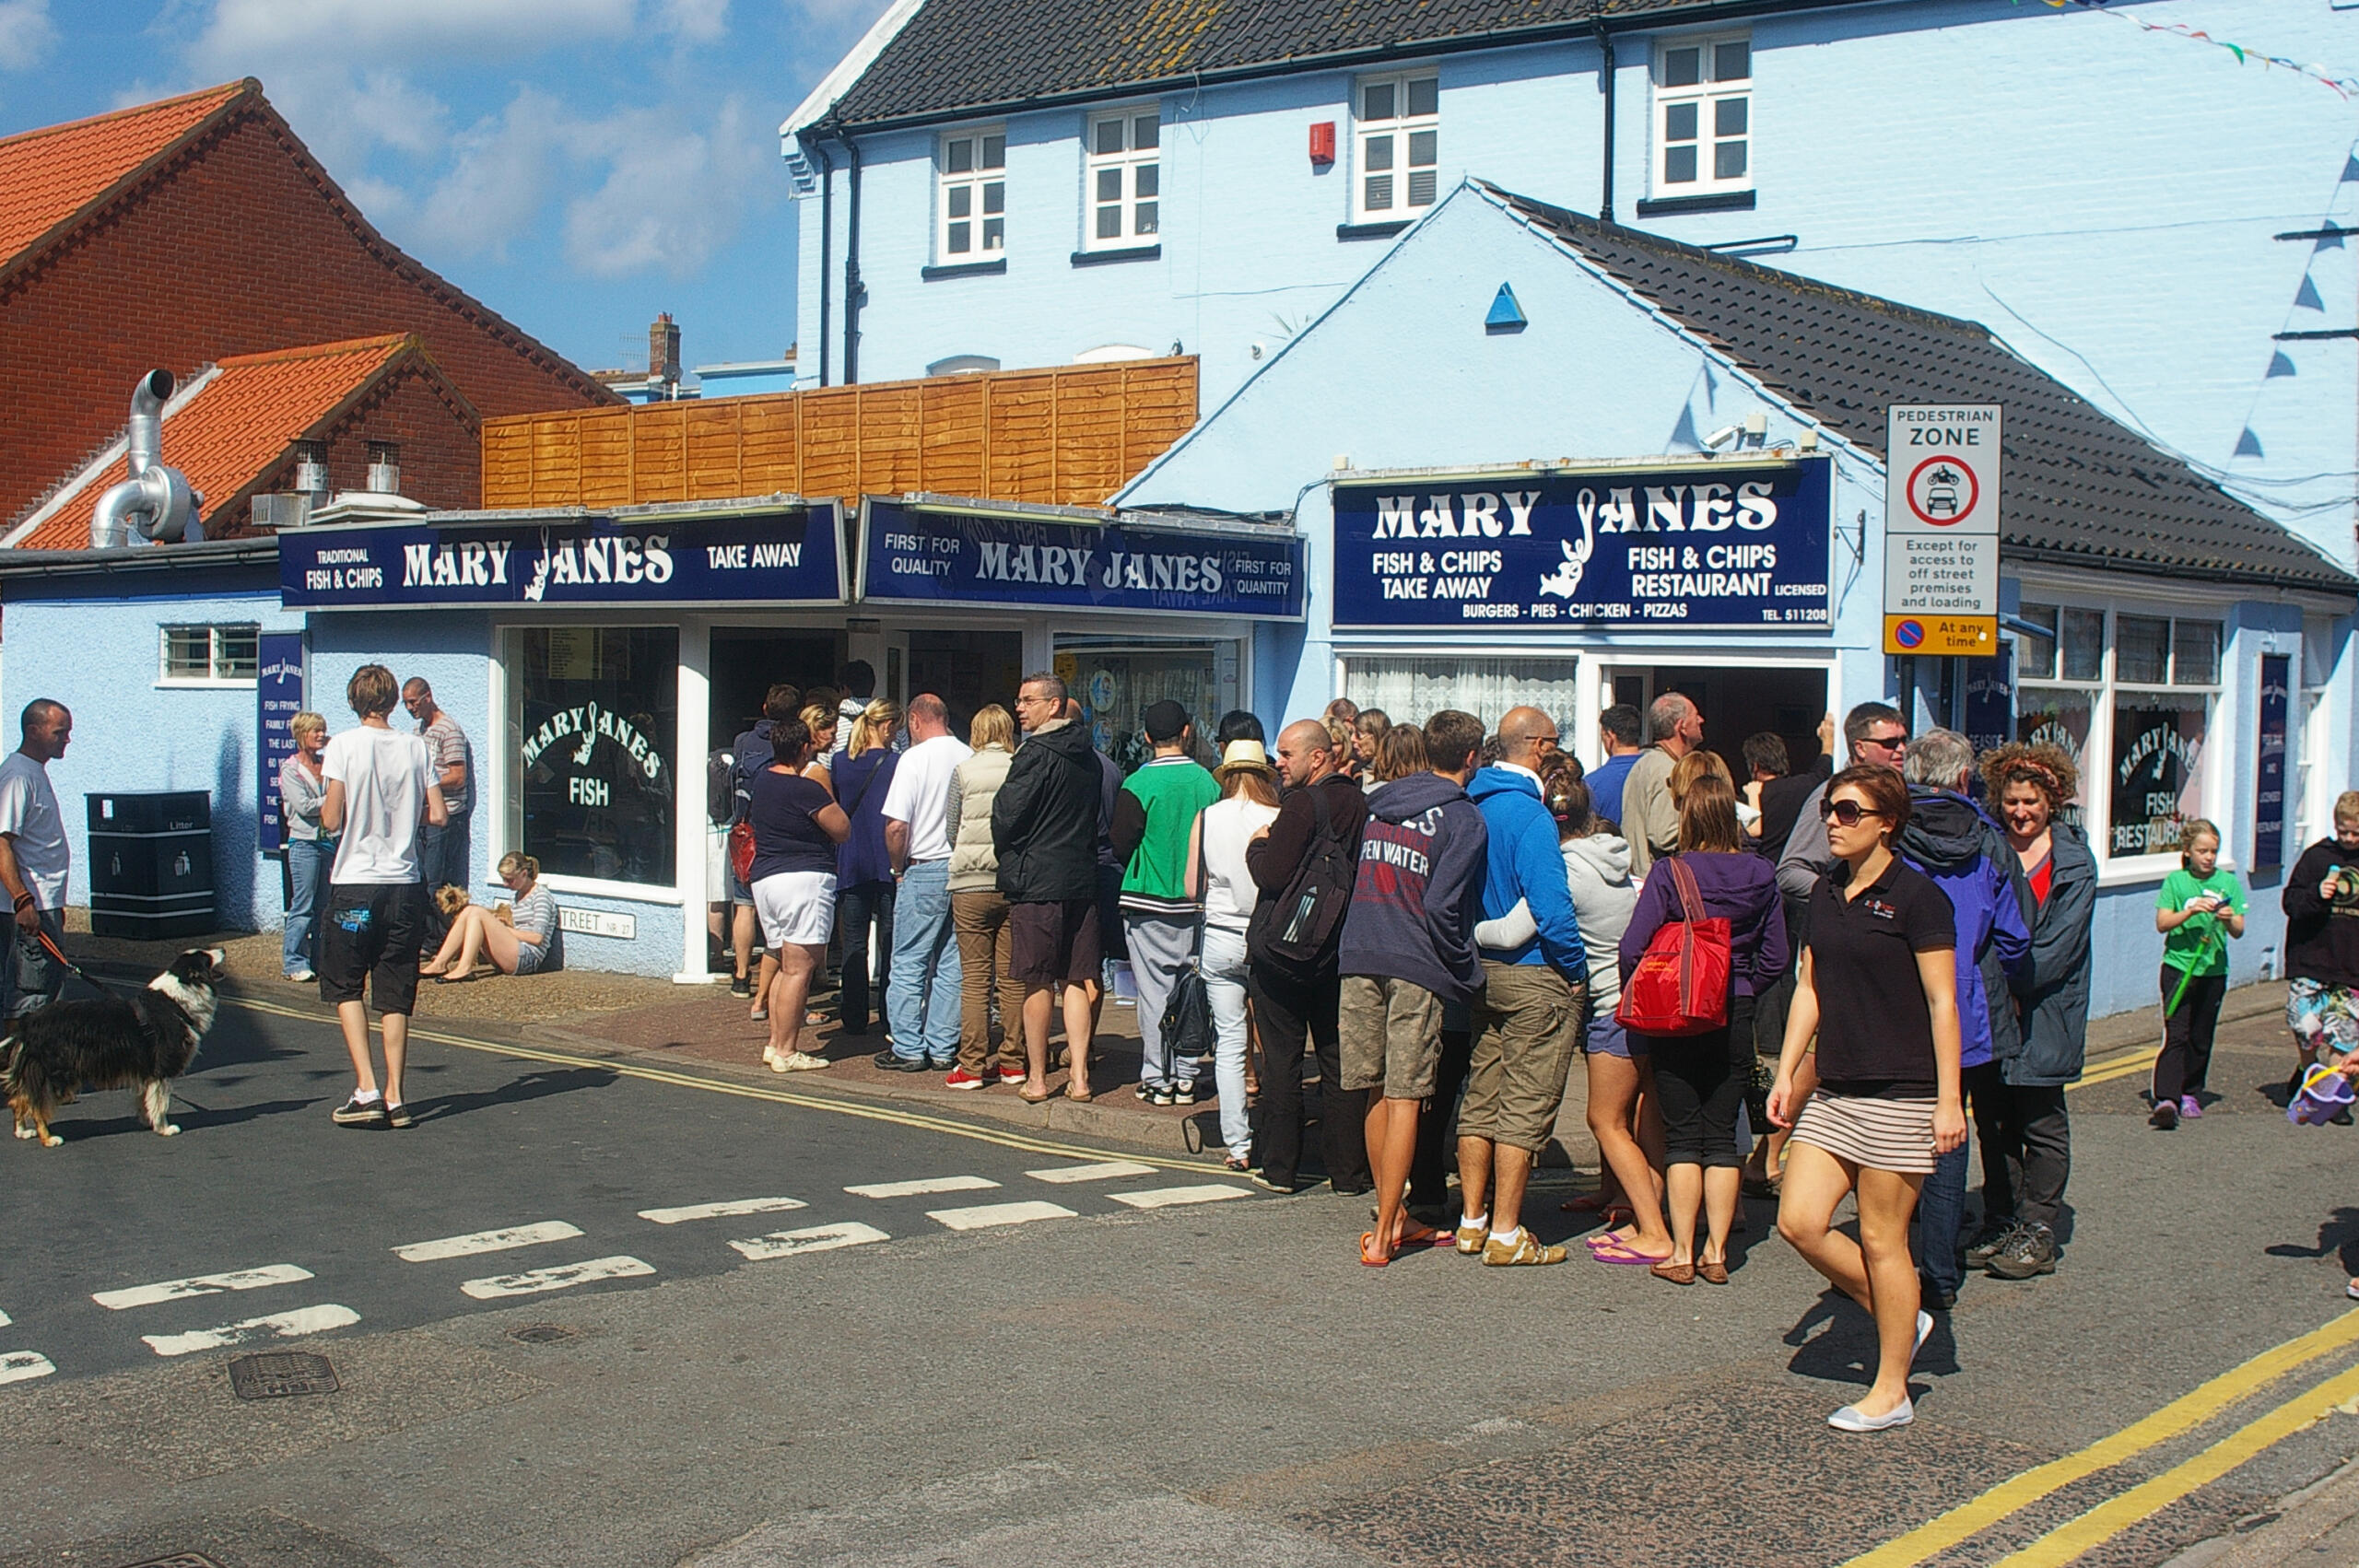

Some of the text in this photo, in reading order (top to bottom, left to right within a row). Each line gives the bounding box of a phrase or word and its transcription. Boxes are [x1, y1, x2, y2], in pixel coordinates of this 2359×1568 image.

[1896, 410, 1994, 423] PEDESTRIAN
[1909, 427, 1980, 446] ZONE
[1371, 481, 1778, 566] MARY JANES
[884, 532, 960, 555] FIRST FOR
[1906, 540, 1978, 554] Except for
[316, 548, 370, 565] TRADITIONAL
[402, 524, 674, 599] MARY JANES
[707, 542, 802, 570] TAKE AWAY
[1372, 550, 1502, 575] FISH & CHIPS
[1627, 544, 1778, 571] FISH & CHIPS
[1909, 555, 1975, 566] access to
[891, 556, 953, 577] QUALITY
[974, 540, 1224, 593] MARY JANES
[1235, 558, 1292, 577] FIRST FOR
[1908, 568, 1975, 580] off street
[306, 567, 383, 591] FISH & CHIPS
[1237, 579, 1290, 597] QUANTITY
[1381, 576, 1493, 601] TAKE AWAY
[1632, 573, 1827, 598] RESTAURANT LICENSED
[1910, 581, 1972, 595] premises
[1462, 603, 1520, 618] BURGERS
[1531, 603, 1558, 618] PIES
[1568, 603, 1632, 618] CHICKEN
[1643, 603, 1688, 618] PIZZAS
[1901, 596, 1982, 611] and loading
[1762, 608, 1827, 622] TEL. 511208
[1939, 621, 1984, 637] At any
[1946, 635, 1977, 647] time
[264, 700, 300, 711] FISH FRYING
[268, 739, 297, 749] THE LAST
[521, 699, 662, 779] MARY JANES
[2118, 720, 2198, 787] MARY JANE
[569, 777, 609, 807] FISH
[2145, 790, 2176, 816] FISH
[170, 820, 194, 831] Litter
[264, 814, 278, 825] FISH
[2116, 819, 2187, 849] RESTAURA
[1359, 839, 1381, 861] PEN
[1383, 840, 1429, 877] WATER
[560, 909, 602, 930] TREET
